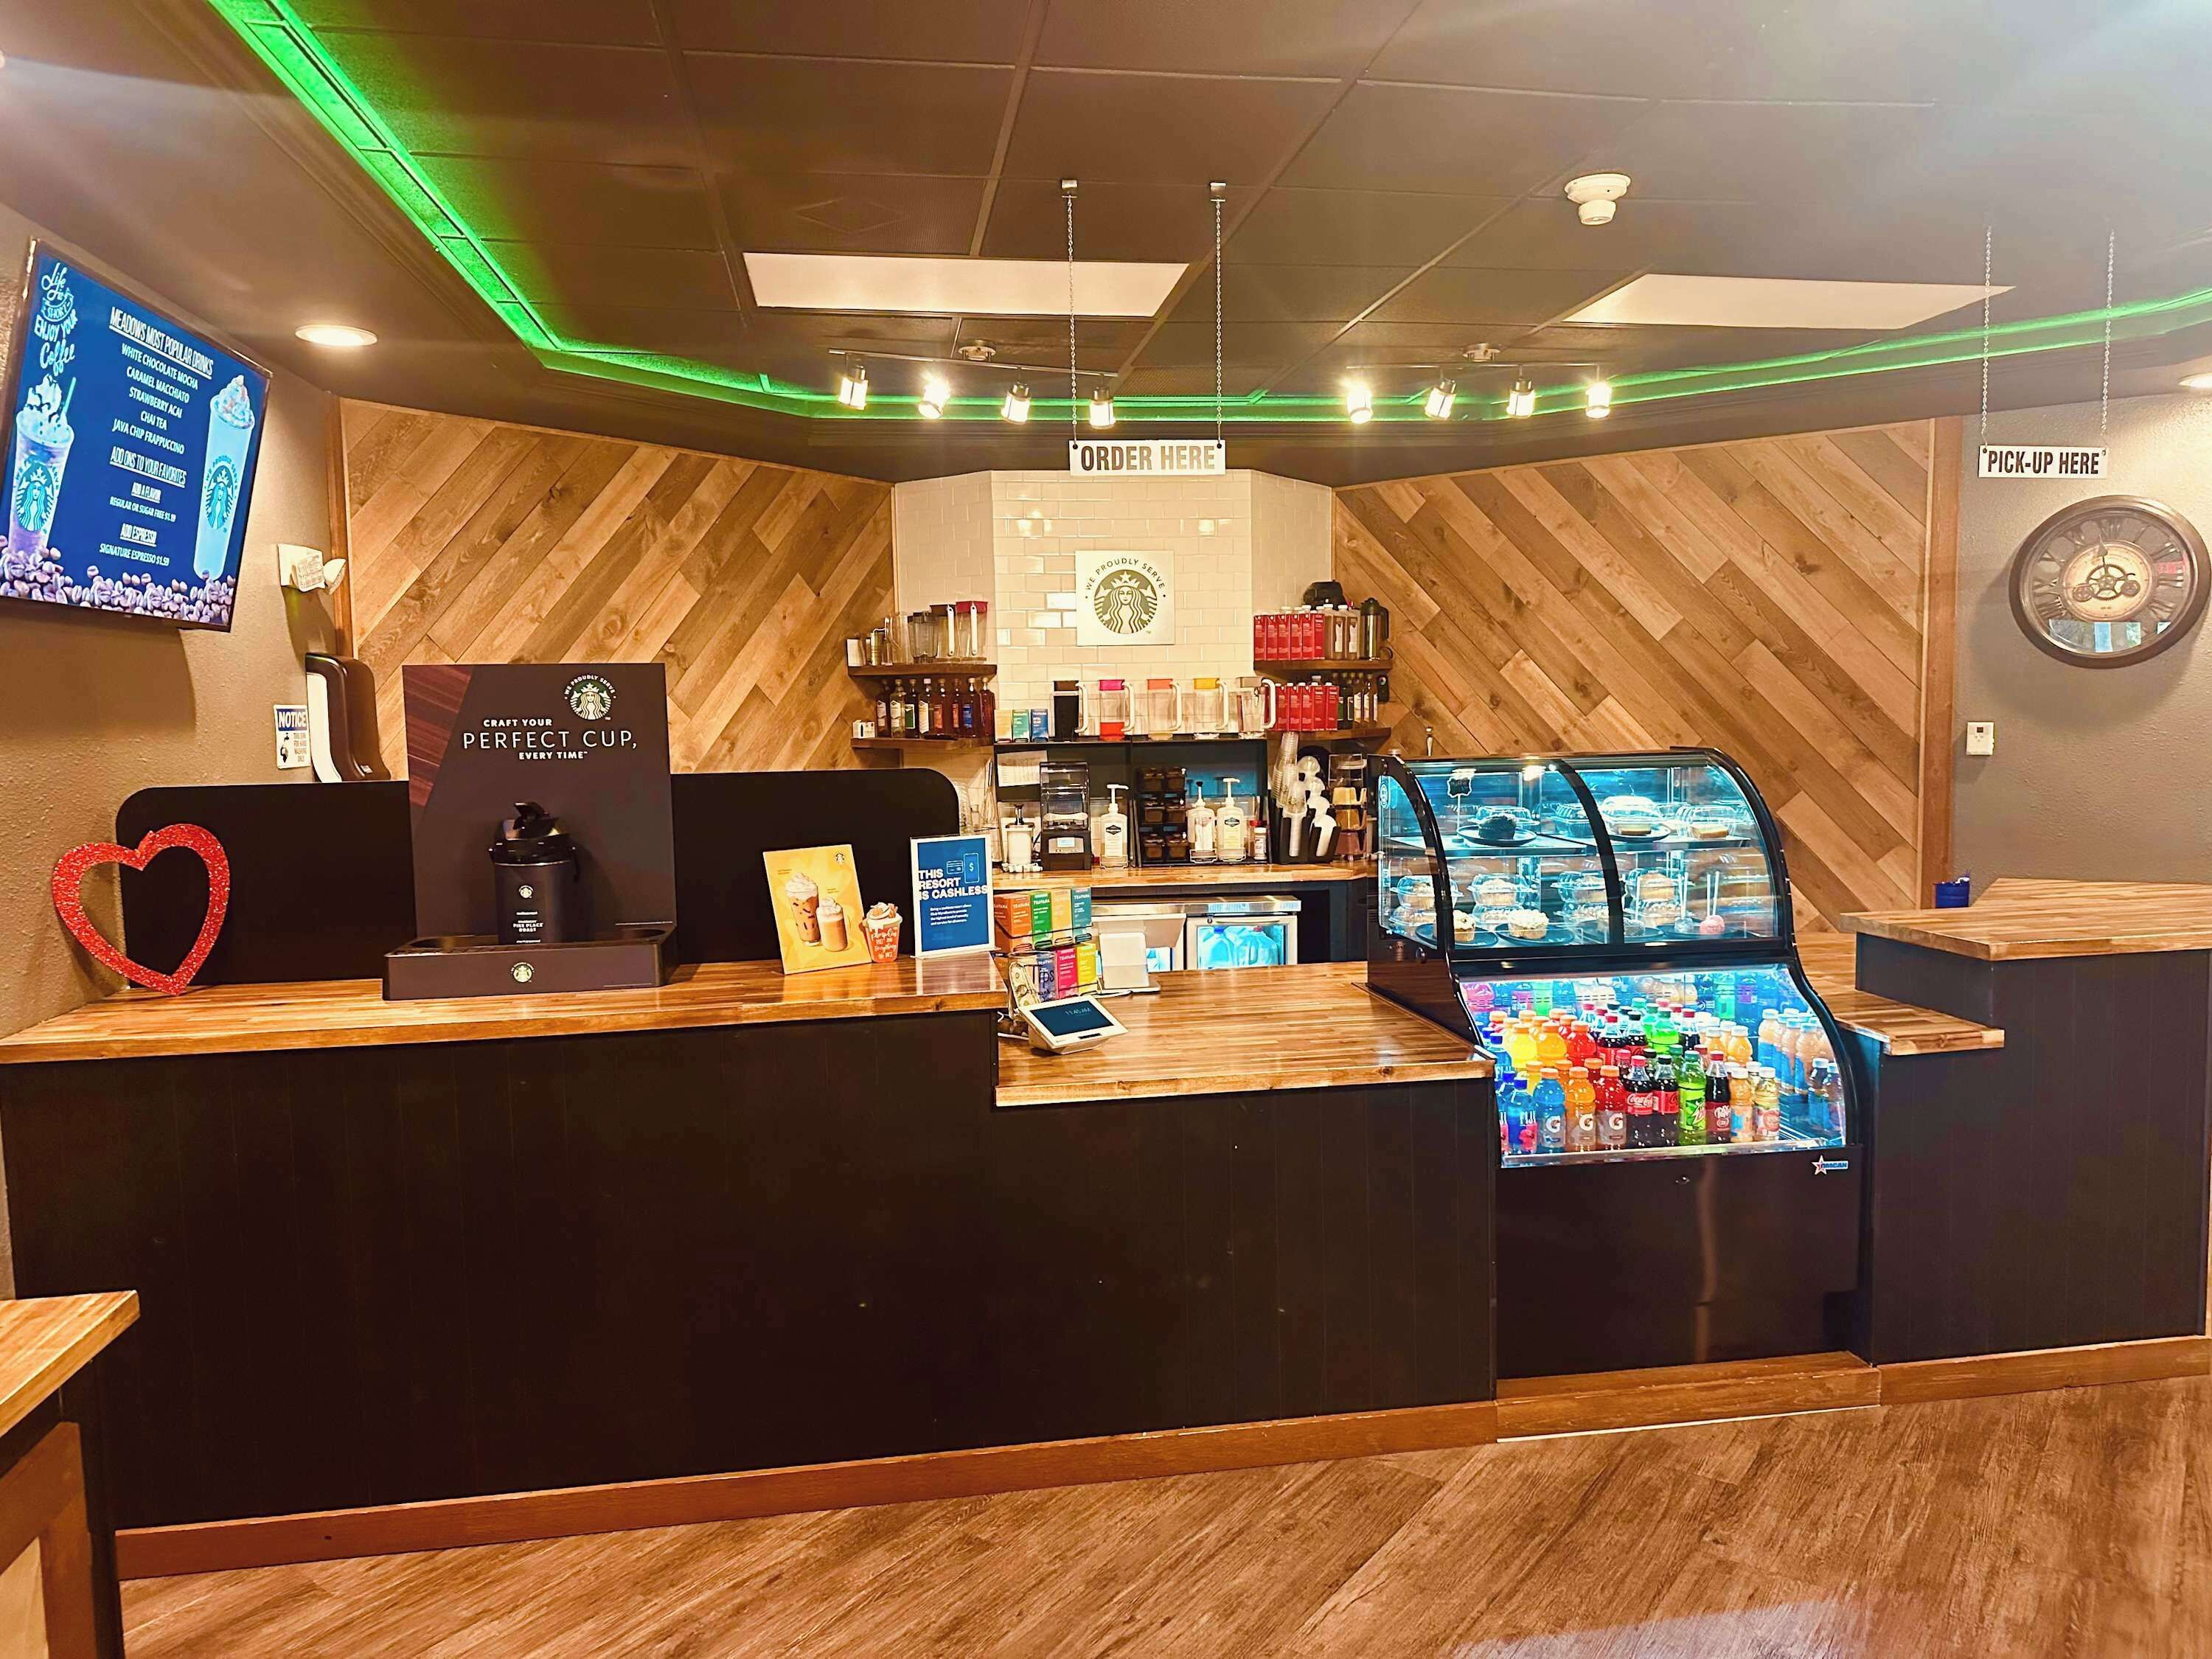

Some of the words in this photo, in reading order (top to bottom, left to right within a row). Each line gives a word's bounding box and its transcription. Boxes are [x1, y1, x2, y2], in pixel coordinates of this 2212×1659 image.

[41, 262, 67, 290] Life
[35, 315, 60, 342] ENJOY
[60, 309, 77, 338] YOUR
[110, 307, 147, 341] MEADOWS
[146, 326, 165, 350] MOST
[164, 336, 192, 365] POPULAR
[192, 351, 214, 375] DRINKS
[40, 339, 75, 376] Coffee
[122, 343, 142, 362] WHITE
[142, 354, 178, 380] CHOCOLATE
[177, 371, 198, 390] MOCHA
[126, 366, 155, 388] CARAMEL
[156, 380, 189, 403] MACCHIATO
[129, 386, 169, 412] STRAWBERRY
[167, 404, 183, 418] ACAI
[141, 411, 156, 425] CHAI
[156, 417, 167, 430] TEA
[112, 419, 129, 434] JAVA
[130, 425, 145, 439] CHIP
[145, 431, 184, 454] FRAPPUCCINO
[111, 446, 125, 464] ADD
[124, 450, 136, 467] ONS
[136, 454, 145, 470] TO
[145, 457, 159, 476] YOUR
[159, 463, 187, 485] FAVORITES
[1081, 445, 1152, 471] ORDER
[1161, 445, 1215, 470] HERE
[1988, 451, 2053, 474] PICK-UP
[2059, 452, 2099, 475] HERE
[131, 482, 142, 495] ADD
[110, 496, 132, 511] REGULAR
[132, 502, 139, 512] OR
[139, 505, 154, 517] SUGAR
[154, 509, 165, 519] FREE
[120, 523, 133, 538] ADD
[133, 526, 157, 544] ESPRESSO
[100, 543, 131, 559] SIGNATURE
[131, 550, 156, 564] ESPRESSO
[1085, 577, 1096, 591] WE
[1096, 558, 1139, 575] PROUDLY
[1141, 563, 1165, 589] SERVE
[563, 686, 572, 695] WE
[570, 674, 599, 686] PROUDLY
[599, 678, 616, 694] SERVE
[278, 712, 307, 728] NOTICE
[483, 719, 518, 728] CRAFT
[521, 718, 552, 726] YOUR
[463, 731, 570, 749] PERFECT
[582, 730, 637, 749] CUP,
[519, 751, 553, 760] EVERY
[919, 869, 944, 880] THIS
[919, 877, 961, 890] RESORT
[919, 890, 930, 900] IS
[931, 885, 987, 900] CASHLESS
[1546, 1116, 1561, 1133] G
[1579, 1113, 1593, 1132] G
[1608, 1113, 1623, 1130] G
